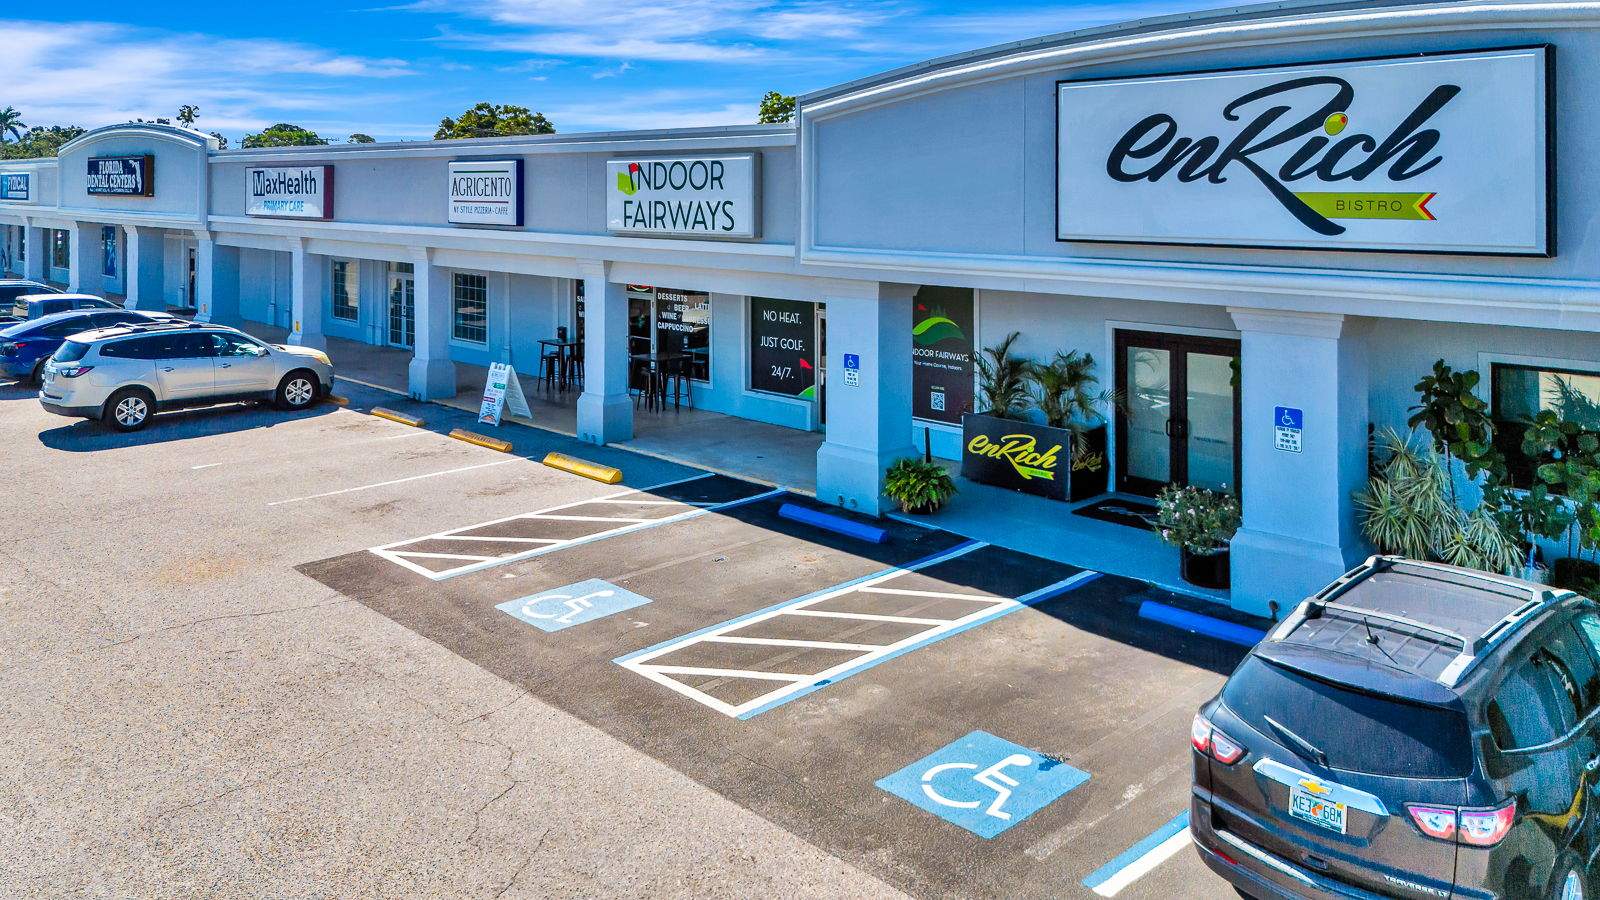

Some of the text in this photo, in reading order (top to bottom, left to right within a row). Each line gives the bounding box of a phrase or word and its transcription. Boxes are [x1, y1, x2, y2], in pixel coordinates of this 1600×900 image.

[1106, 75, 1461, 236] enRich
[98, 160, 123, 174] FLORIDA
[88, 174, 136, 189] DENTAL CENTERS
[253, 170, 317, 196] MaxHealth
[628, 160, 725, 191] INDOOR
[451, 177, 512, 197] AGRIGENTO
[263, 200, 304, 212] PRIMARY CARE
[1335, 198, 1403, 213] BISTRO
[623, 200, 735, 231] FAIRWAYS
[657, 292, 688, 303] DESSERTS
[673, 303, 690, 312] BEER
[661, 311, 677, 320] WINE
[763, 310, 802, 324] NO HEAT.
[657, 321, 694, 333] CAPPUCCINO
[761, 335, 805, 352] JUST GOLF.
[935, 350, 970, 362] FAIRWAYS
[771, 365, 794, 380] 24/7.
[967, 433, 1062, 480] enRich
[1292, 794, 1312, 813] KE3
